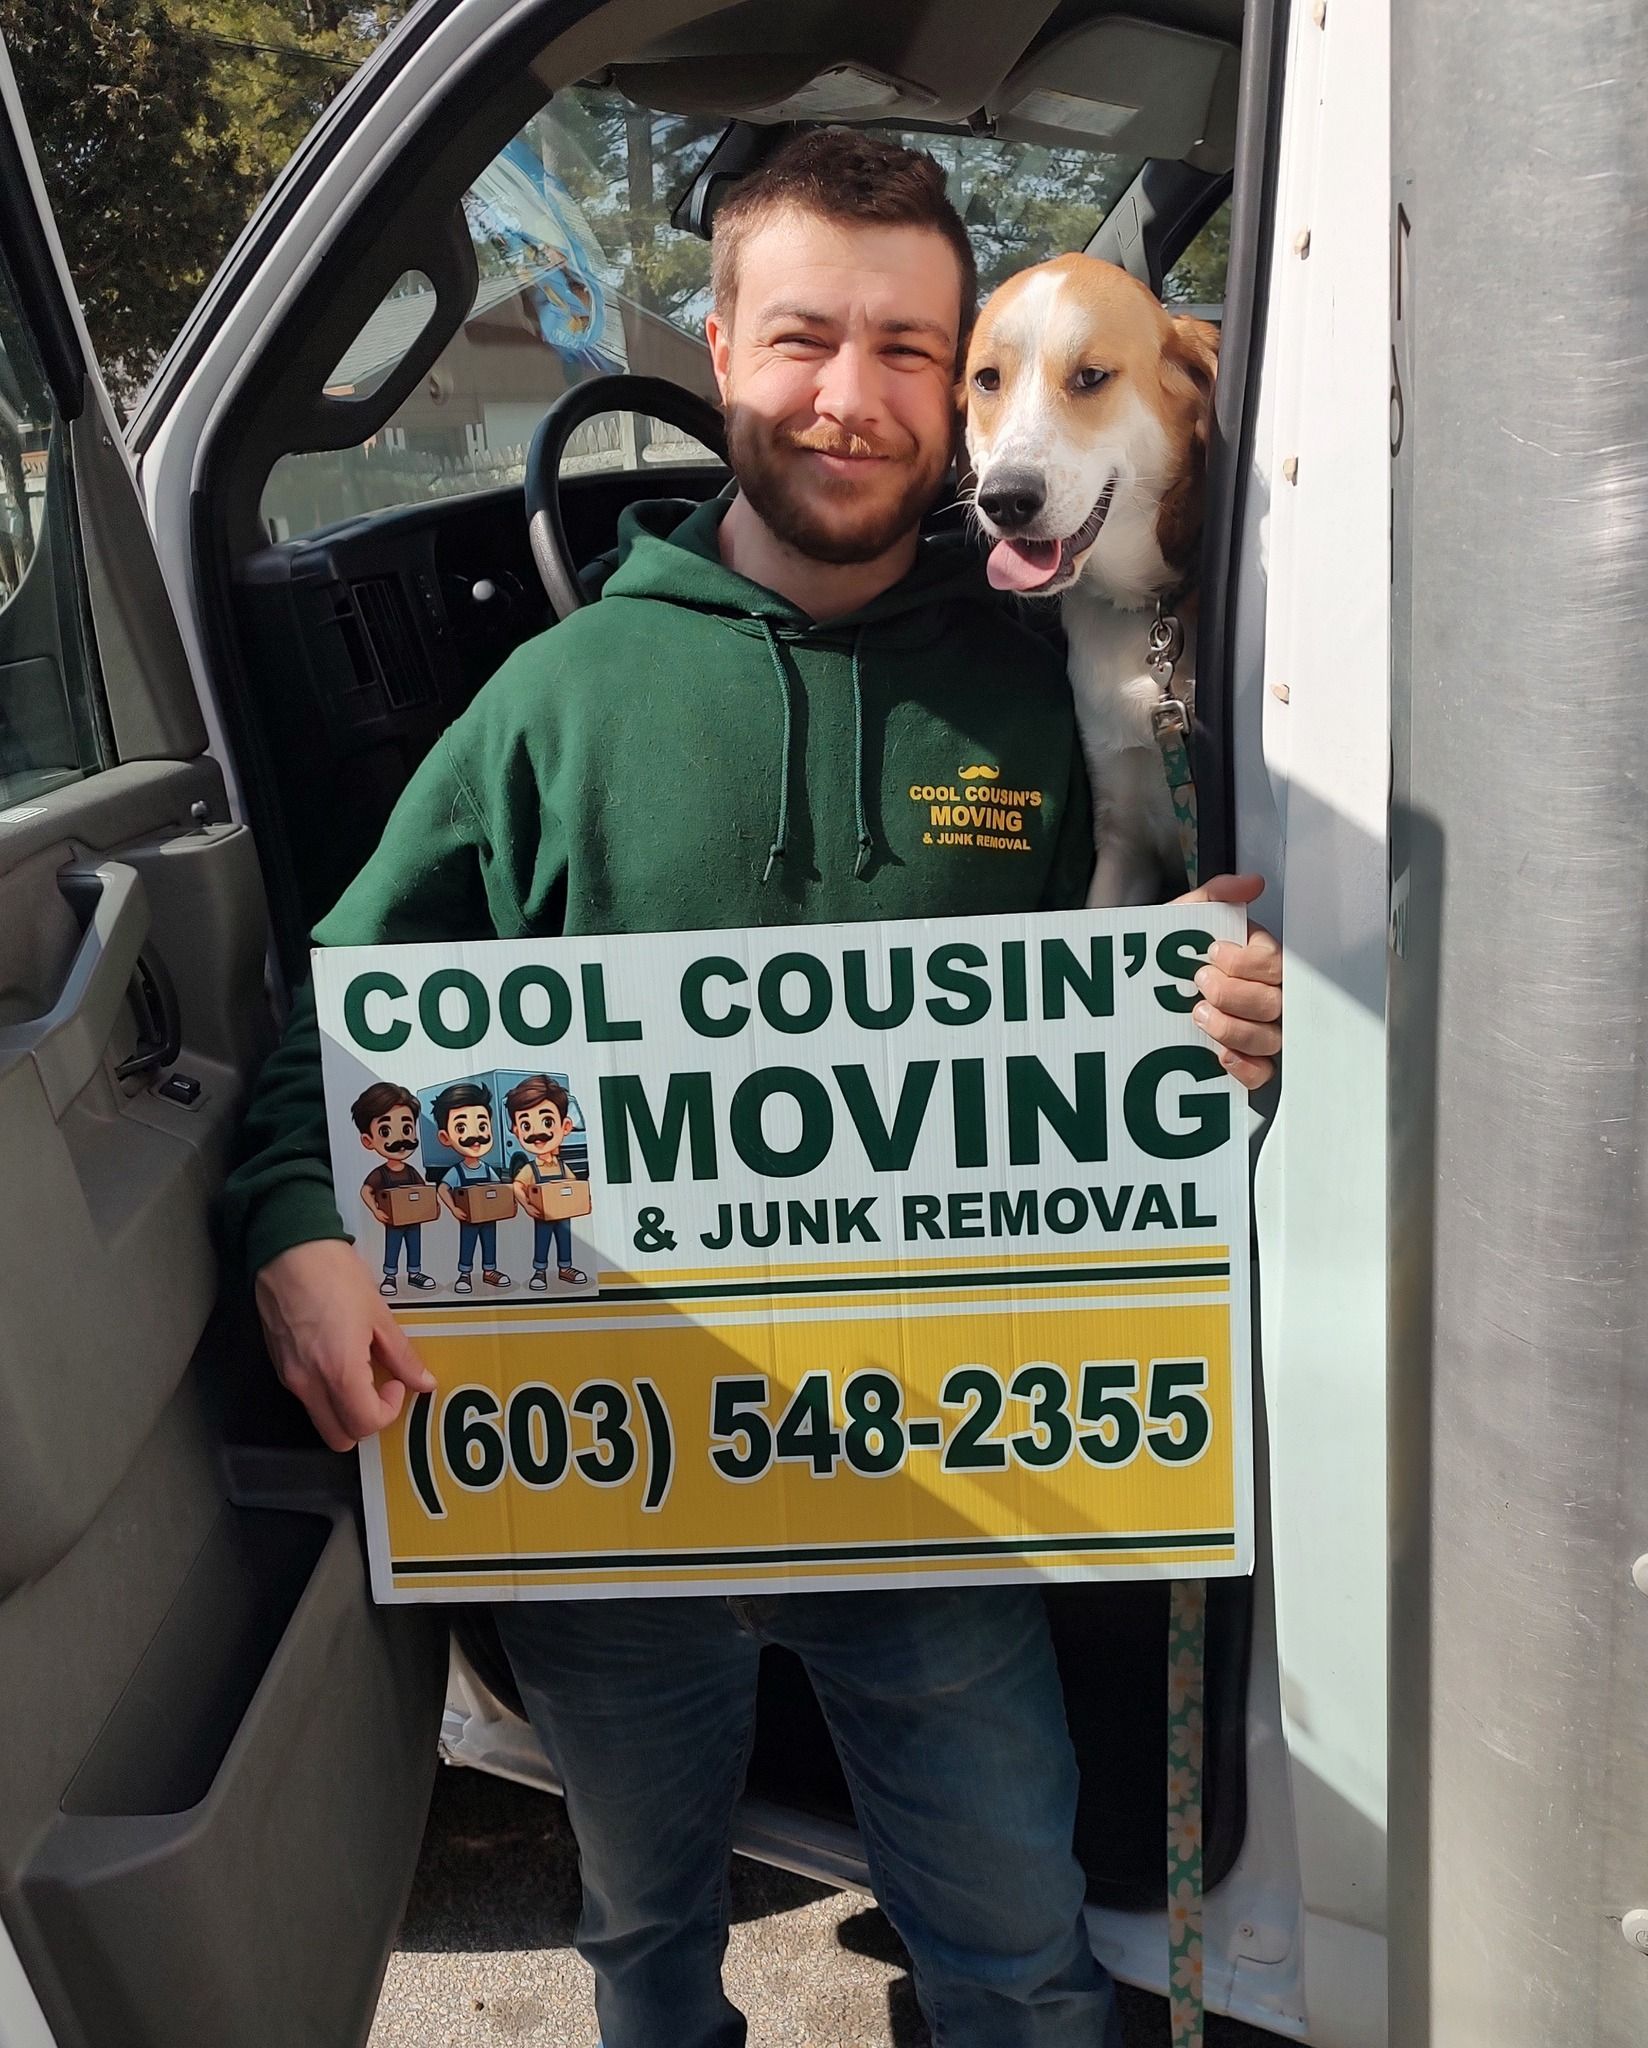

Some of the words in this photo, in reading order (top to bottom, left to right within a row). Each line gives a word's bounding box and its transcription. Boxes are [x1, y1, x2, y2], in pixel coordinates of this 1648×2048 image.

[909, 786, 960, 802] COOL
[965, 786, 1042, 806] COUSIN'S
[930, 805, 1023, 832] MOVING
[922, 832, 933, 845] &
[937, 833, 973, 846] JUNK
[976, 834, 1031, 850] REMOVAL
[343, 962, 643, 1053] COOL
[680, 928, 1218, 1039] COUSIN'S
[598, 1045, 1231, 1185] MOVING
[633, 1206, 678, 1252] &
[700, 1196, 882, 1250] JUNK
[902, 1182, 1218, 1242] REMOVAL
[405, 1377, 675, 1519] (603)
[709, 1357, 1213, 1483] 548-2355
